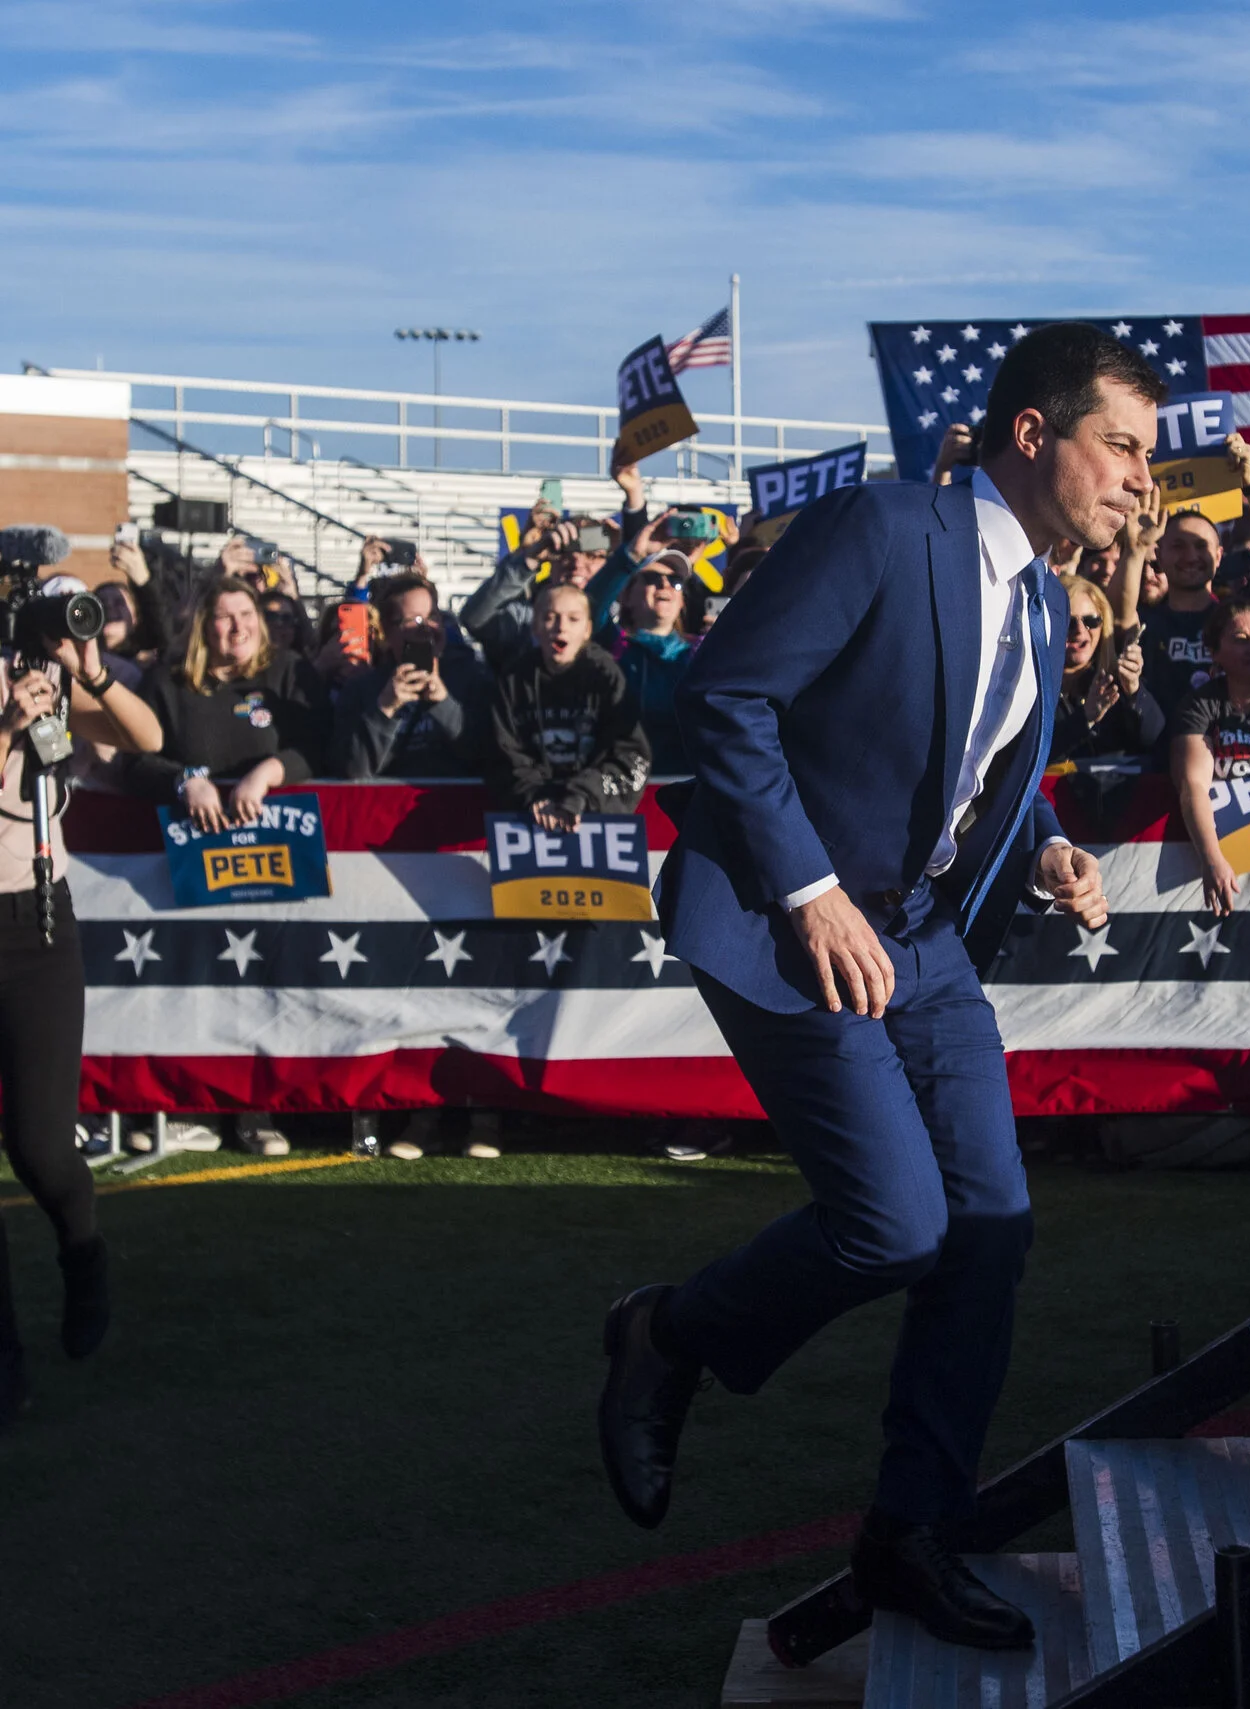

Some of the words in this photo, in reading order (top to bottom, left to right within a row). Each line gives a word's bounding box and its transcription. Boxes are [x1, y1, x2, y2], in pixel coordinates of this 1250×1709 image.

[619, 345, 674, 411] ETE
[1157, 399, 1226, 451] TE
[167, 804, 318, 846] SNTS
[231, 832, 258, 846] FOR
[210, 852, 286, 881] PETE
[494, 822, 640, 873] PETE
[540, 889, 603, 907] 2020
